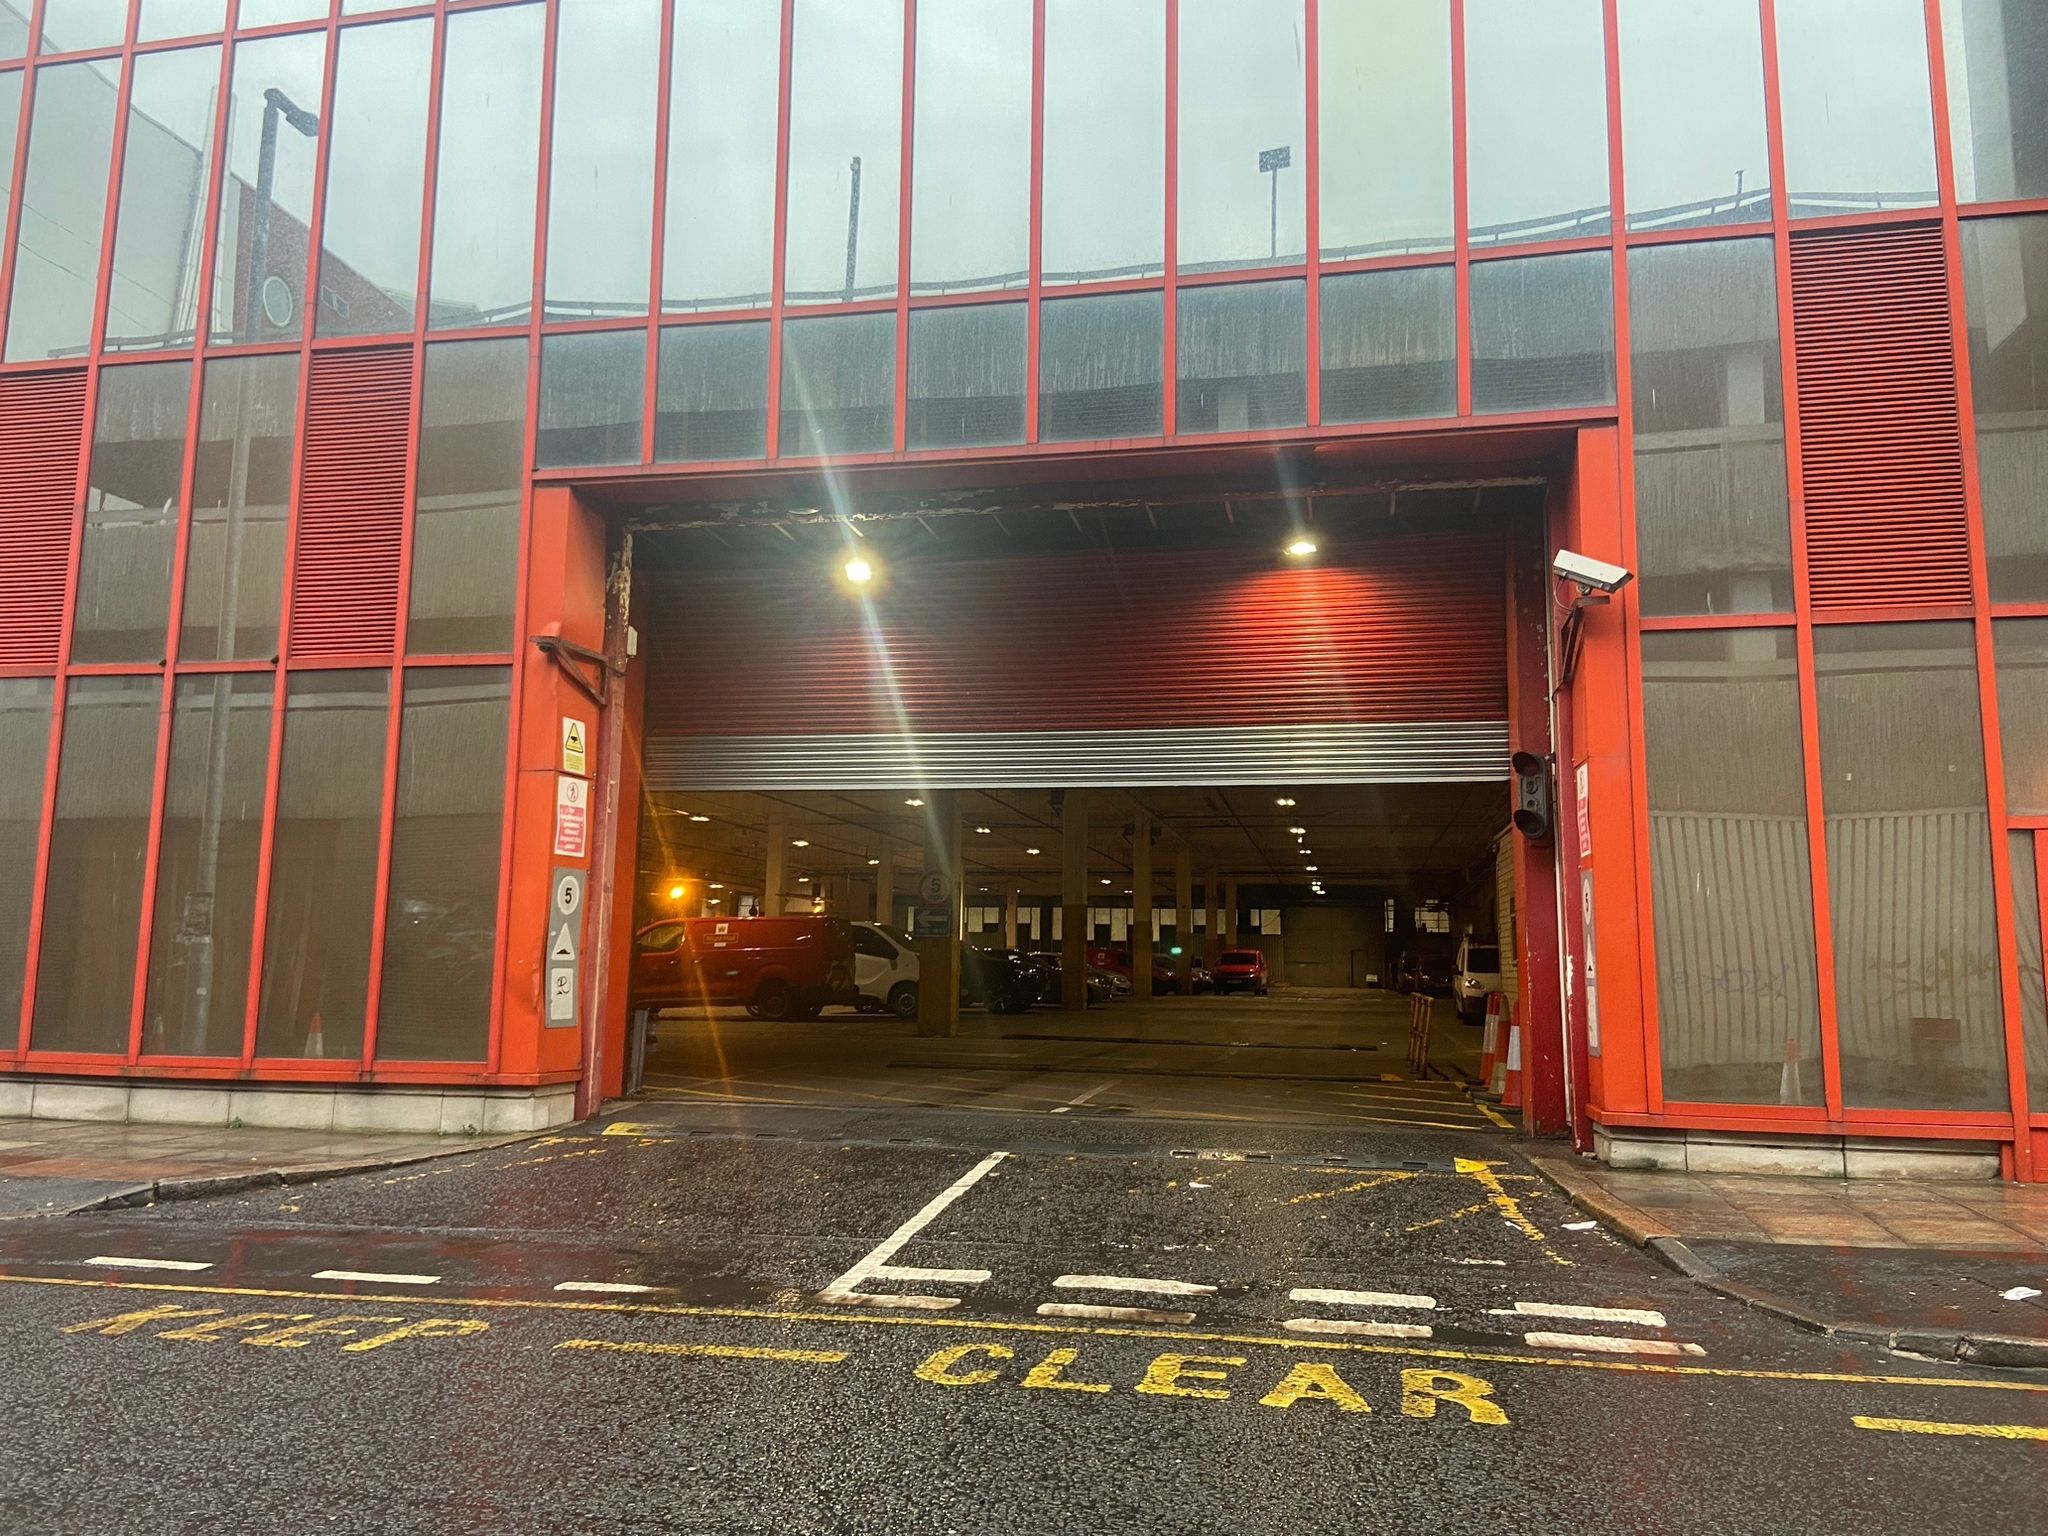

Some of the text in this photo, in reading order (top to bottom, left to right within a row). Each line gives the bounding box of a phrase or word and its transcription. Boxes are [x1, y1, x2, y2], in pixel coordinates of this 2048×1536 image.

[565, 887, 573, 904] 5
[931, 878, 941, 893] 5
[60, 1304, 490, 1353] KEEP
[912, 1343, 1511, 1426] CLEAR
